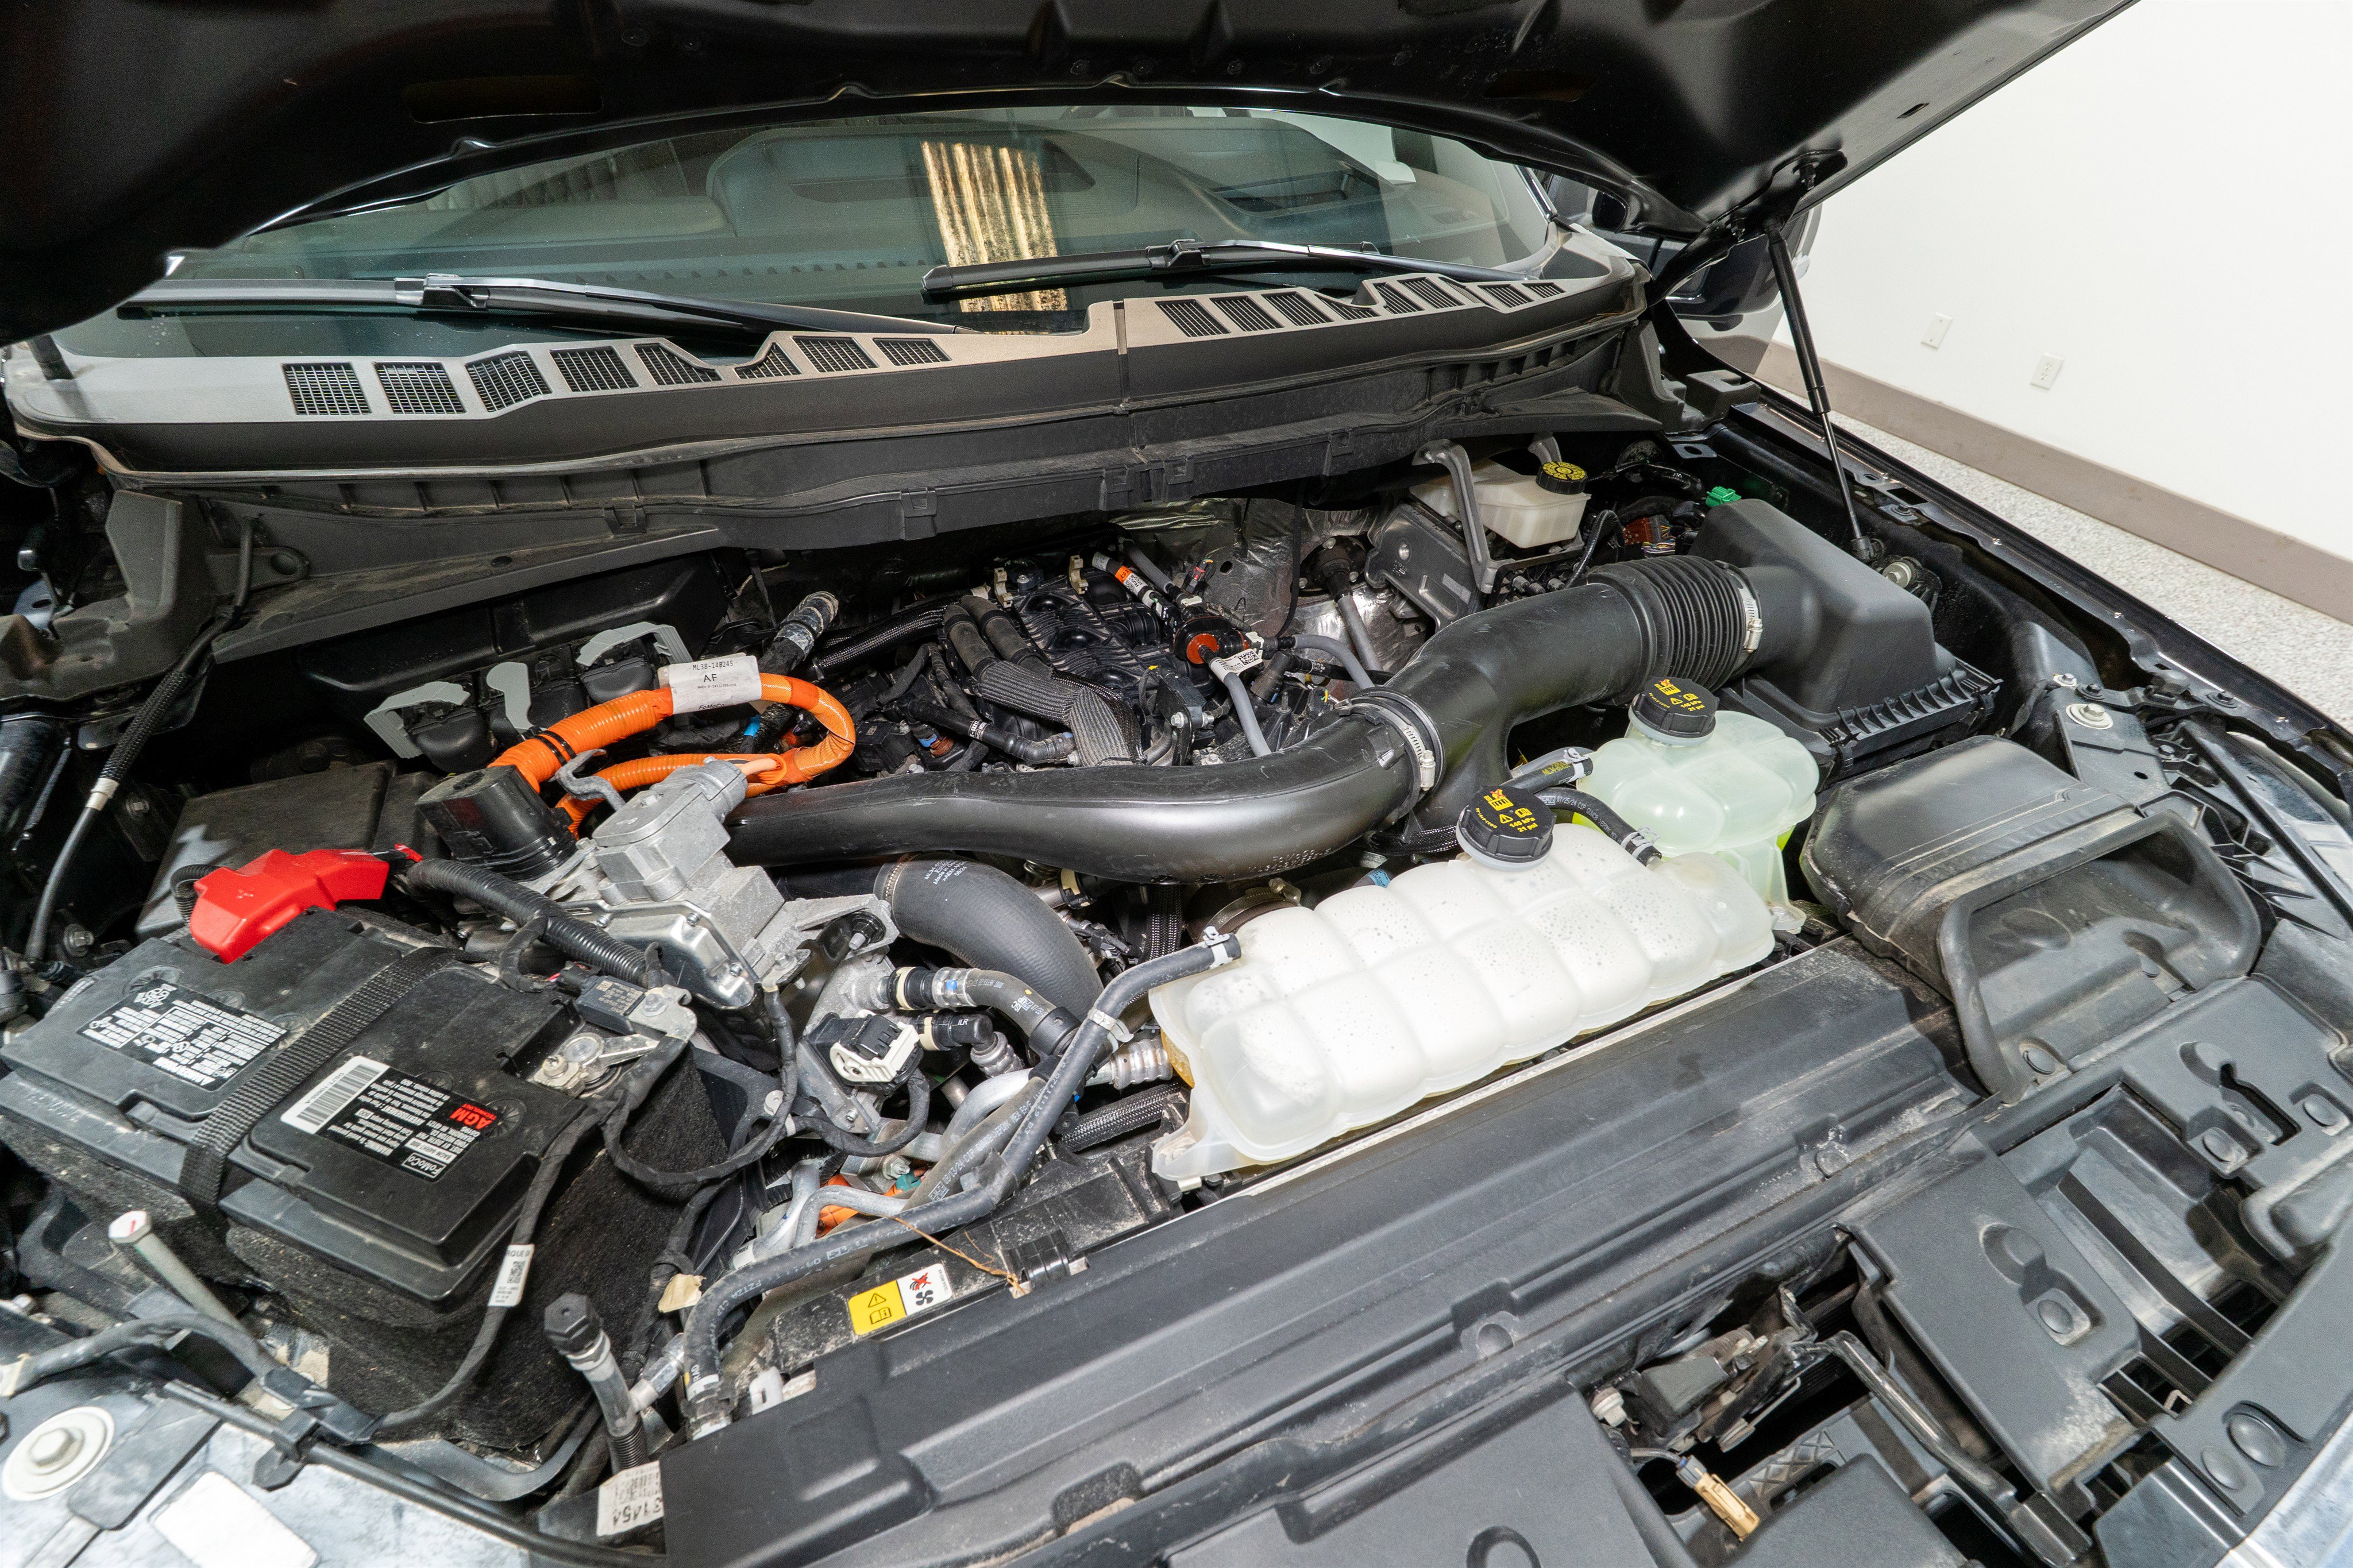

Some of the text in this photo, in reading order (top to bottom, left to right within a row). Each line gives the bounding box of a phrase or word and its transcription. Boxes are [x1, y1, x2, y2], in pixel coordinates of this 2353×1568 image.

[692, 660, 734, 671] ML38-14B245
[703, 673, 718, 682] AF
[1509, 816, 1536, 828] 145 kPa
[1526, 822, 1538, 831] psi
[932, 871, 944, 884] Made
[1009, 1000, 1023, 1013] ISC
[379, 1104, 426, 1126] AVERTISSEMENT
[448, 1106, 493, 1131] AGM
[436, 1131, 457, 1143] MOTOR
[452, 1138, 469, 1148] FORD
[405, 1154, 443, 1175] FoMoCo
[691, 1364, 701, 1382] RAD
